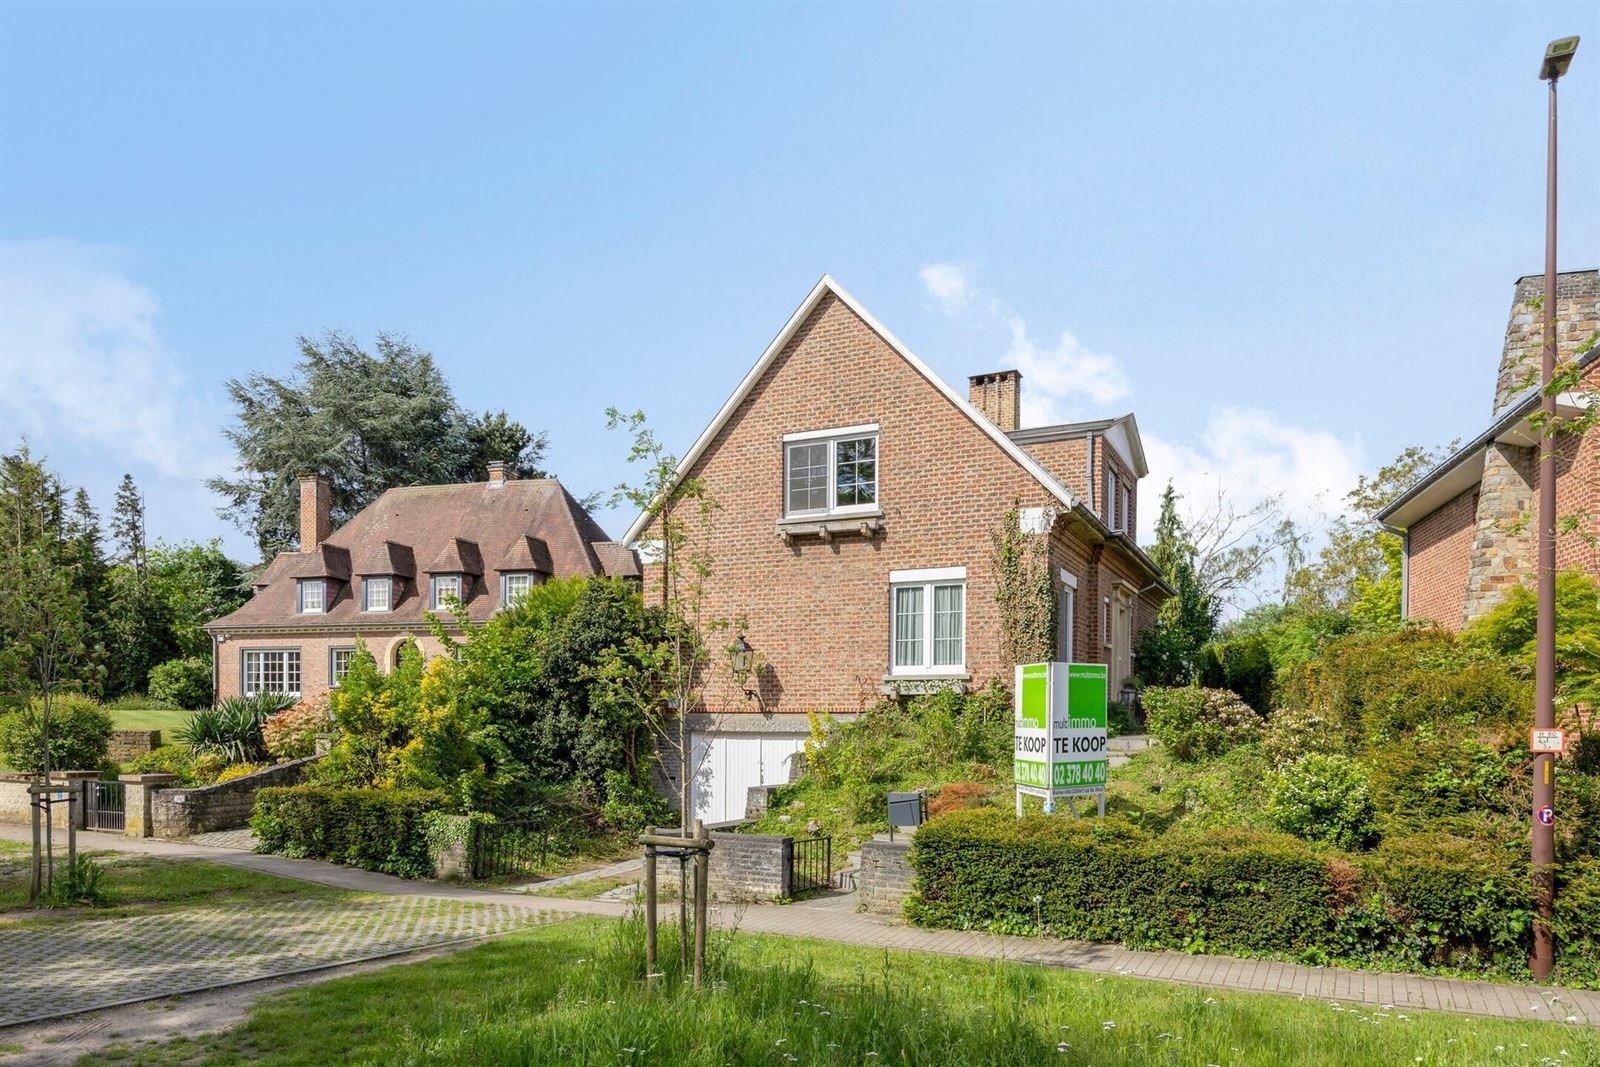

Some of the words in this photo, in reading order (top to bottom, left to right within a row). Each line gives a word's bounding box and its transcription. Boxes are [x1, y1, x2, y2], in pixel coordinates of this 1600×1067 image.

[1054, 714, 1097, 730] multimmo
[1015, 736, 1022, 751] TE
[1023, 736, 1047, 753] KOOP
[1053, 738, 1069, 754] TE
[1072, 736, 1106, 753] KOOP
[1054, 764, 1065, 785] 02
[1066, 763, 1081, 784] 378
[1082, 762, 1094, 783] 40
[1094, 761, 1106, 782] 40
